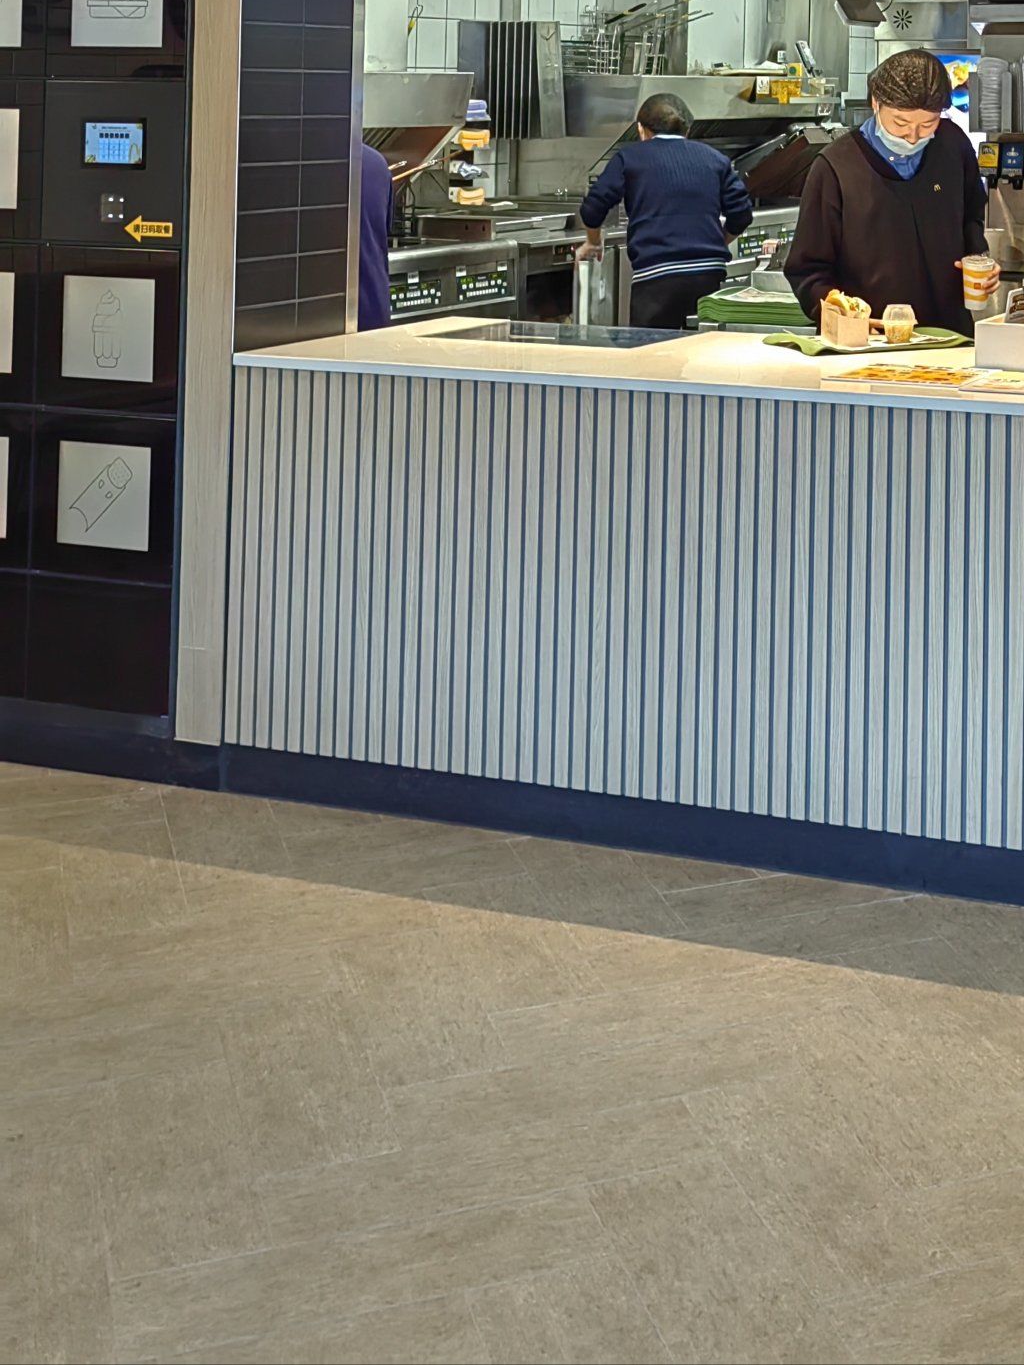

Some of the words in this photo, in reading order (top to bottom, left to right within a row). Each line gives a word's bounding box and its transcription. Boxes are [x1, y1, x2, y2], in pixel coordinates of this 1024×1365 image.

[133, 224, 171, 234] 请扫码取餐
